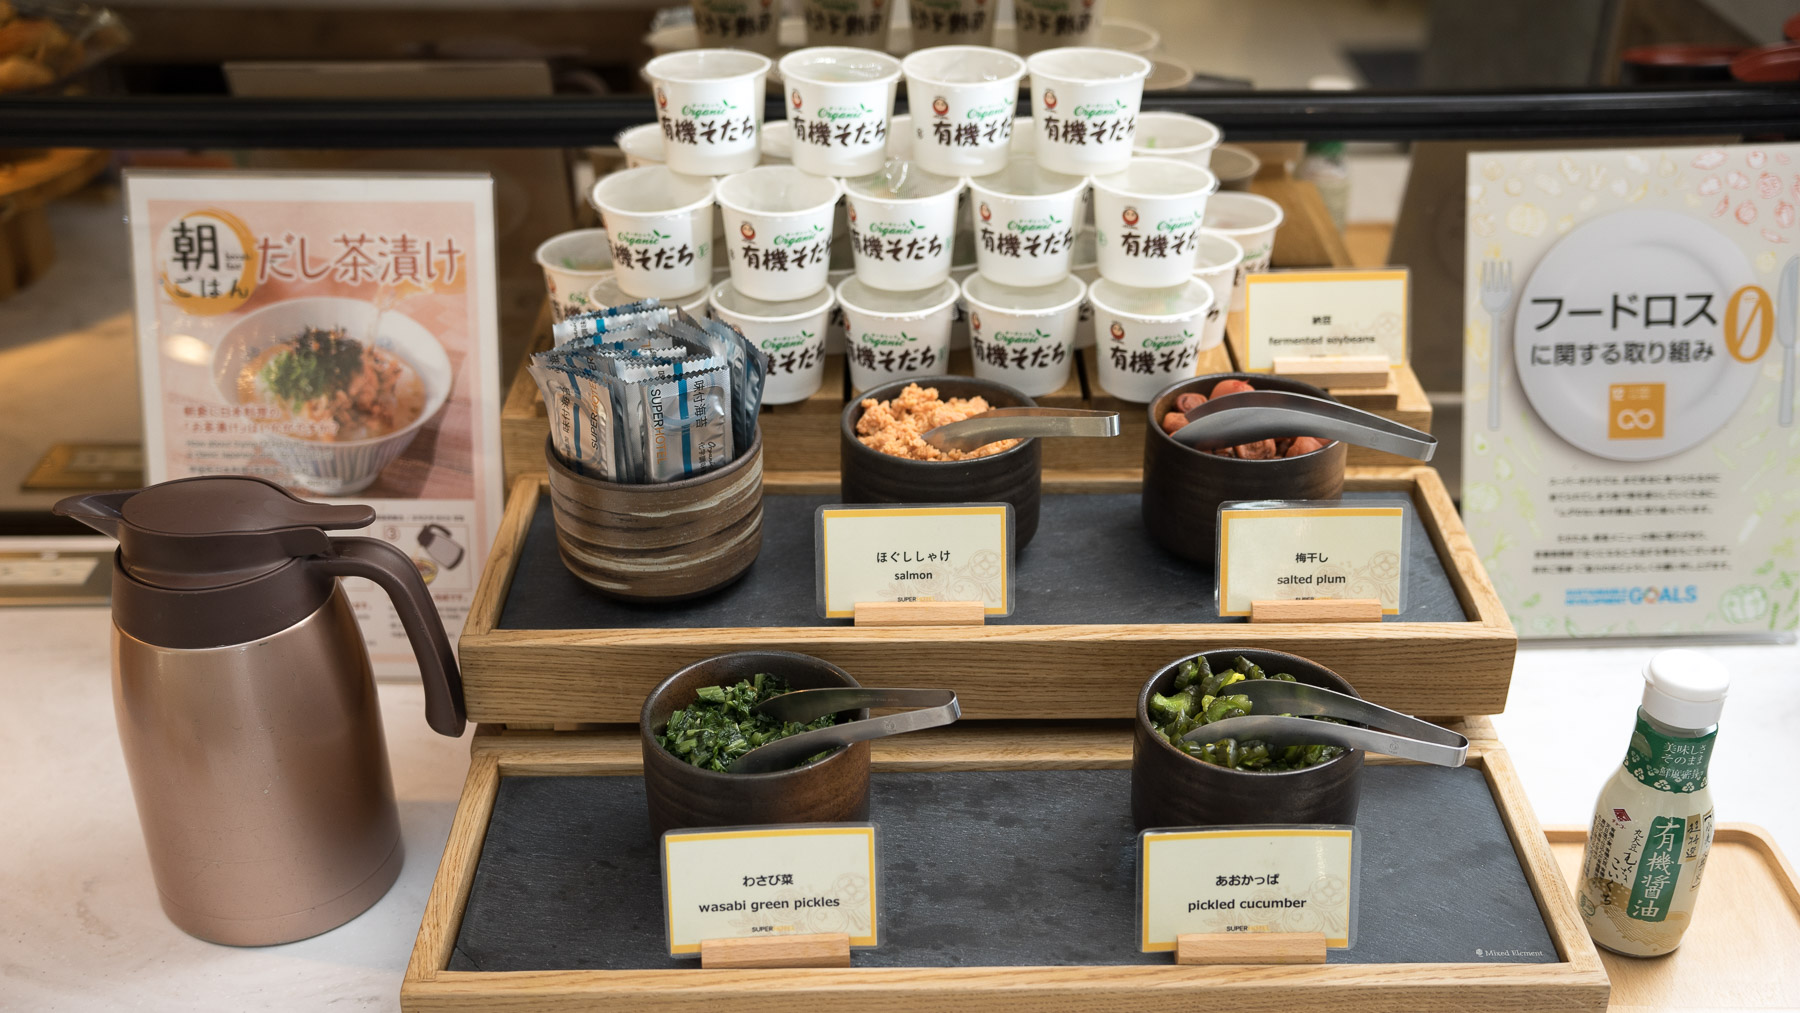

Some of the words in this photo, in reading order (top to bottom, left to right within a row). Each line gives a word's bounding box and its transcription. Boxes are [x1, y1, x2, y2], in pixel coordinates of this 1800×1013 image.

[662, 115, 754, 145] 有機そだち
[793, 115, 887, 147] 有機そだち
[172, 222, 219, 271] 朝
[257, 233, 463, 283] だし茶漬け
[174, 276, 249, 298] ごはん
[1531, 293, 1718, 331] フードロス
[1269, 336, 1323, 346] fermented
[1326, 335, 1376, 346] soybeans
[1530, 340, 1716, 367] に関する取り組み
[692, 380, 708, 428] 味付海苔
[589, 381, 601, 450] SUPERHOTE
[650, 388, 668, 465] SUPERHOTEL
[876, 550, 951, 563] ほぐししゃけ
[1295, 552, 1329, 564] 梅干し
[894, 571, 933, 580] salmon
[1277, 574, 1313, 585] salted
[1316, 574, 1346, 586] plum
[1663, 742, 1707, 756] 美味しさ
[1661, 753, 1703, 765] そのまま
[742, 873, 794, 887] わさび菜
[1215, 872, 1280, 887] あおかっぱ
[698, 900, 747, 913] wasabi
[750, 901, 789, 913] green
[794, 897, 840, 909] pickles
[1188, 899, 1236, 913] pickled
[1239, 897, 1308, 909] cucumber
